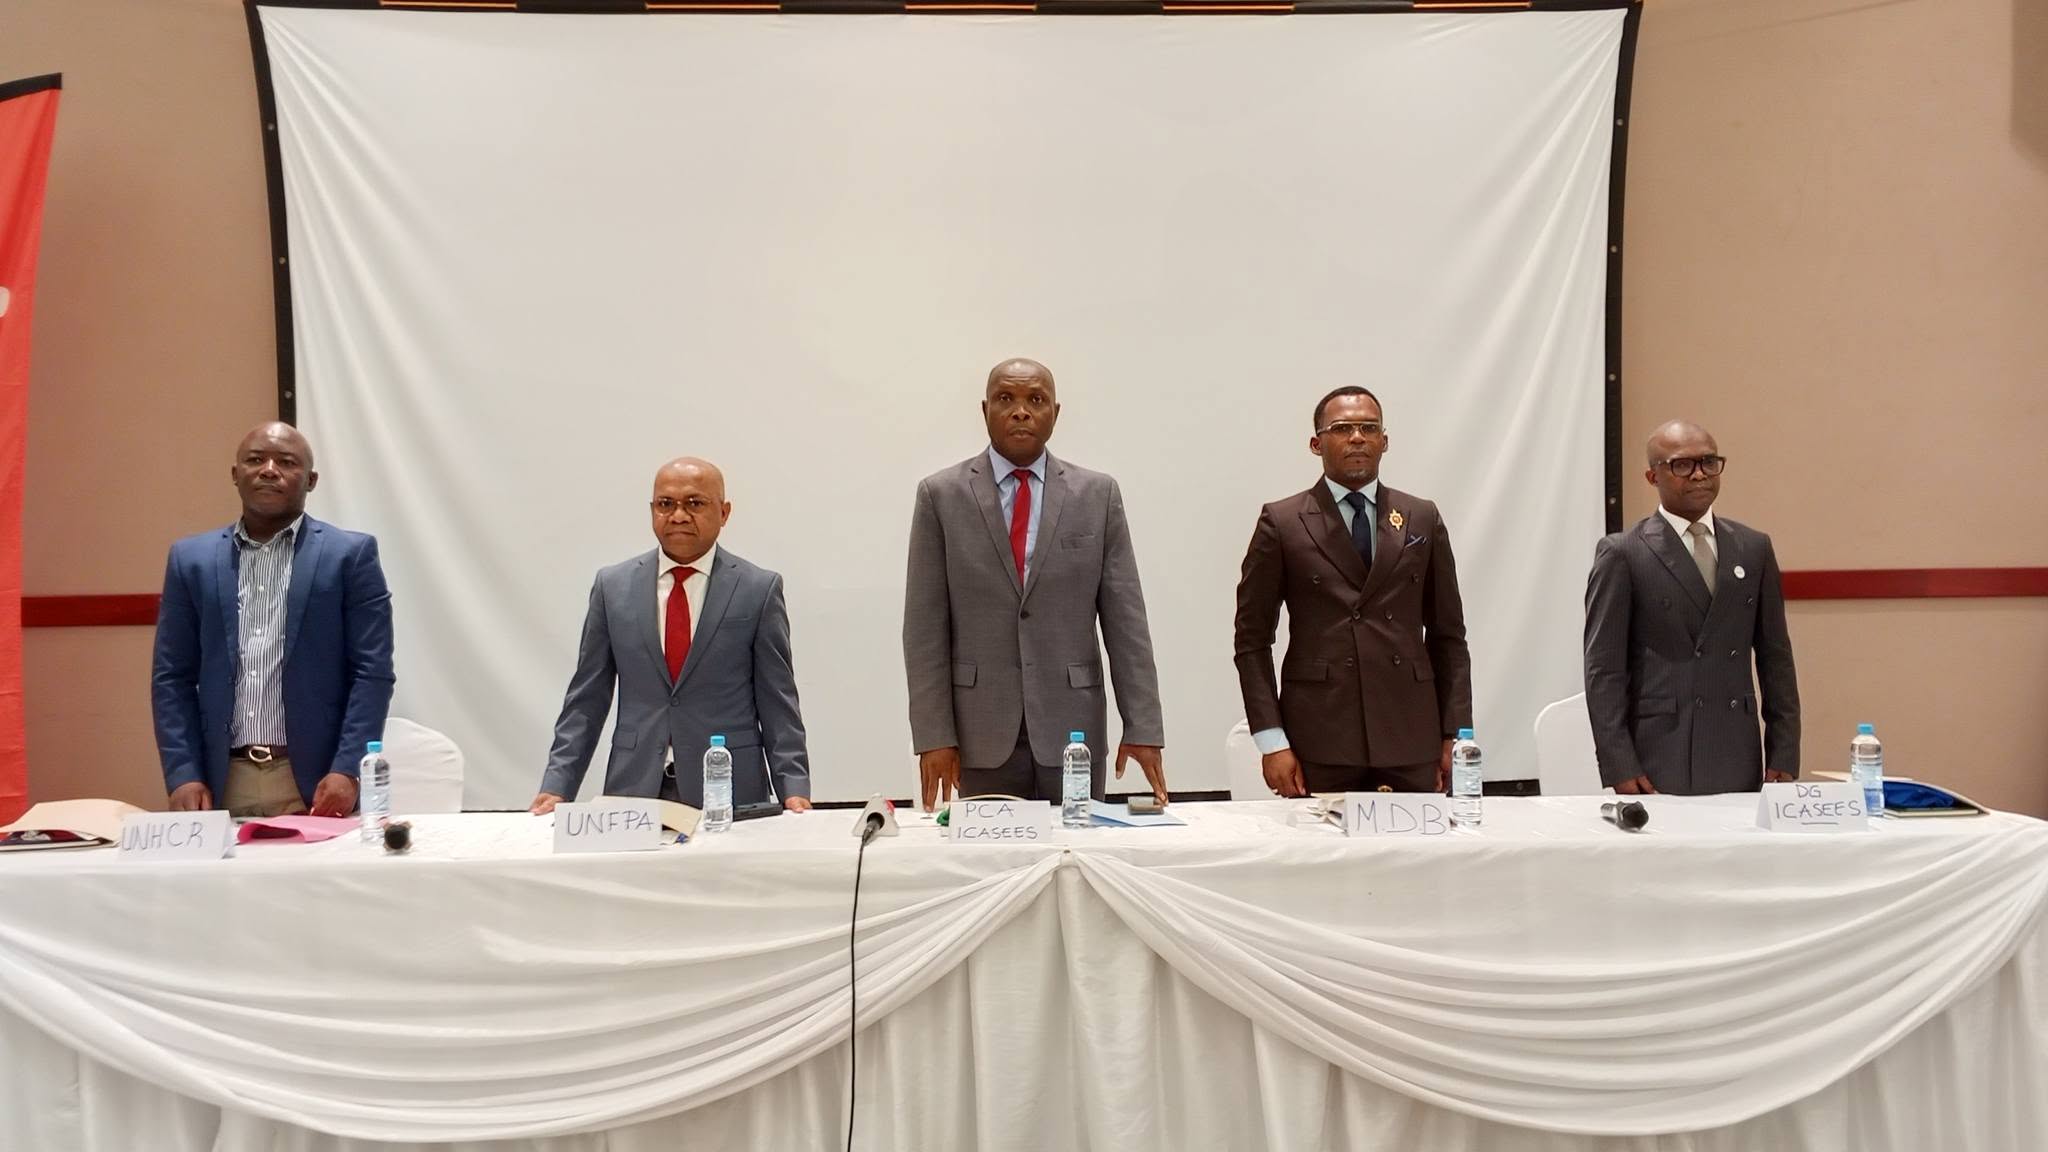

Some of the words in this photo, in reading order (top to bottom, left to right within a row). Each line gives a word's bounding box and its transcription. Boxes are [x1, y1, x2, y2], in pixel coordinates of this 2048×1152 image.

[1795, 784, 1822, 798] DG
[965, 802, 1015, 818] PCA
[1775, 800, 1862, 819] ICASEES
[567, 810, 655, 836] UNFPA
[121, 822, 204, 851] UNHCR
[957, 826, 1039, 840] ICASEES
